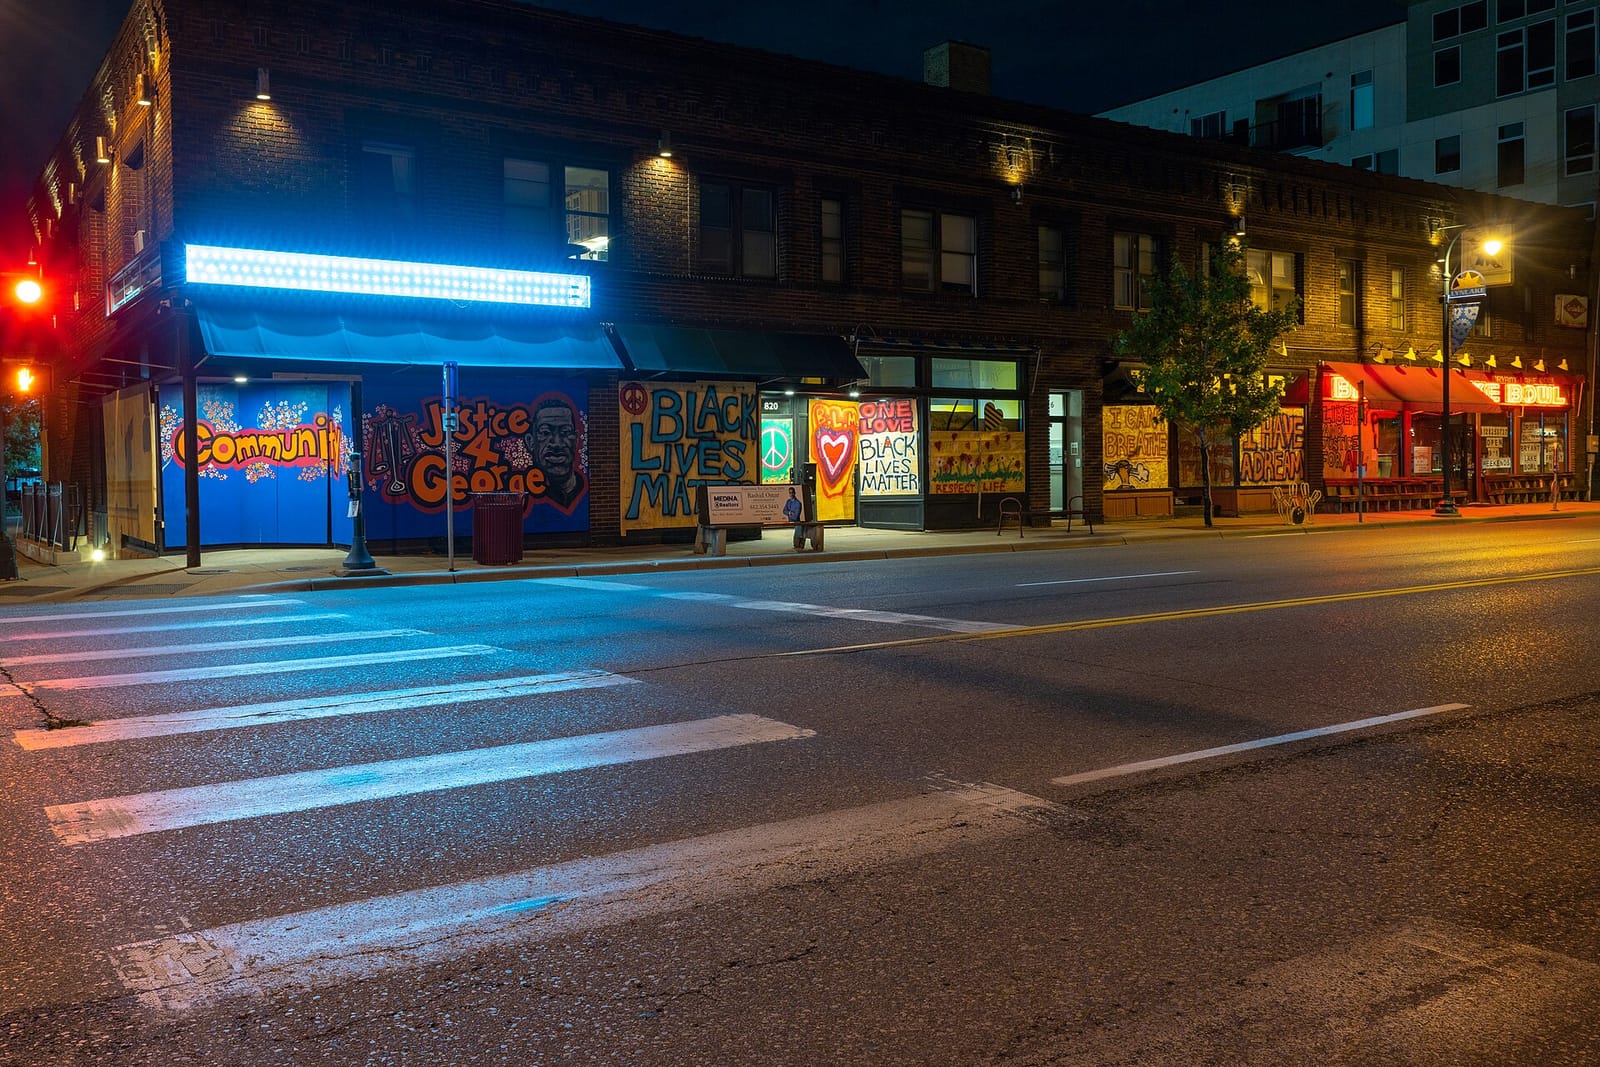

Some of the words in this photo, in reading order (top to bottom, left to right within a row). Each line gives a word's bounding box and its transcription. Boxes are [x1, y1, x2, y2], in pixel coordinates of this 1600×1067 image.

[1505, 383, 1566, 405] BOWL
[651, 385, 757, 443] BLACK
[764, 402, 778, 411] 820
[859, 400, 913, 418] ONE
[859, 417, 914, 435] LOVE
[1109, 407, 1121, 429] I
[1260, 412, 1304, 450] HAVE
[173, 414, 341, 478] Community
[462, 428, 500, 469] 4
[631, 422, 746, 480] LIVES
[860, 435, 916, 460] BLACK
[1105, 431, 1168, 458] BREATHE
[865, 459, 912, 474] LIVES
[861, 473, 919, 492] MATTER
[935, 483, 975, 494] RESPECT
[982, 481, 1007, 493] LIFE
